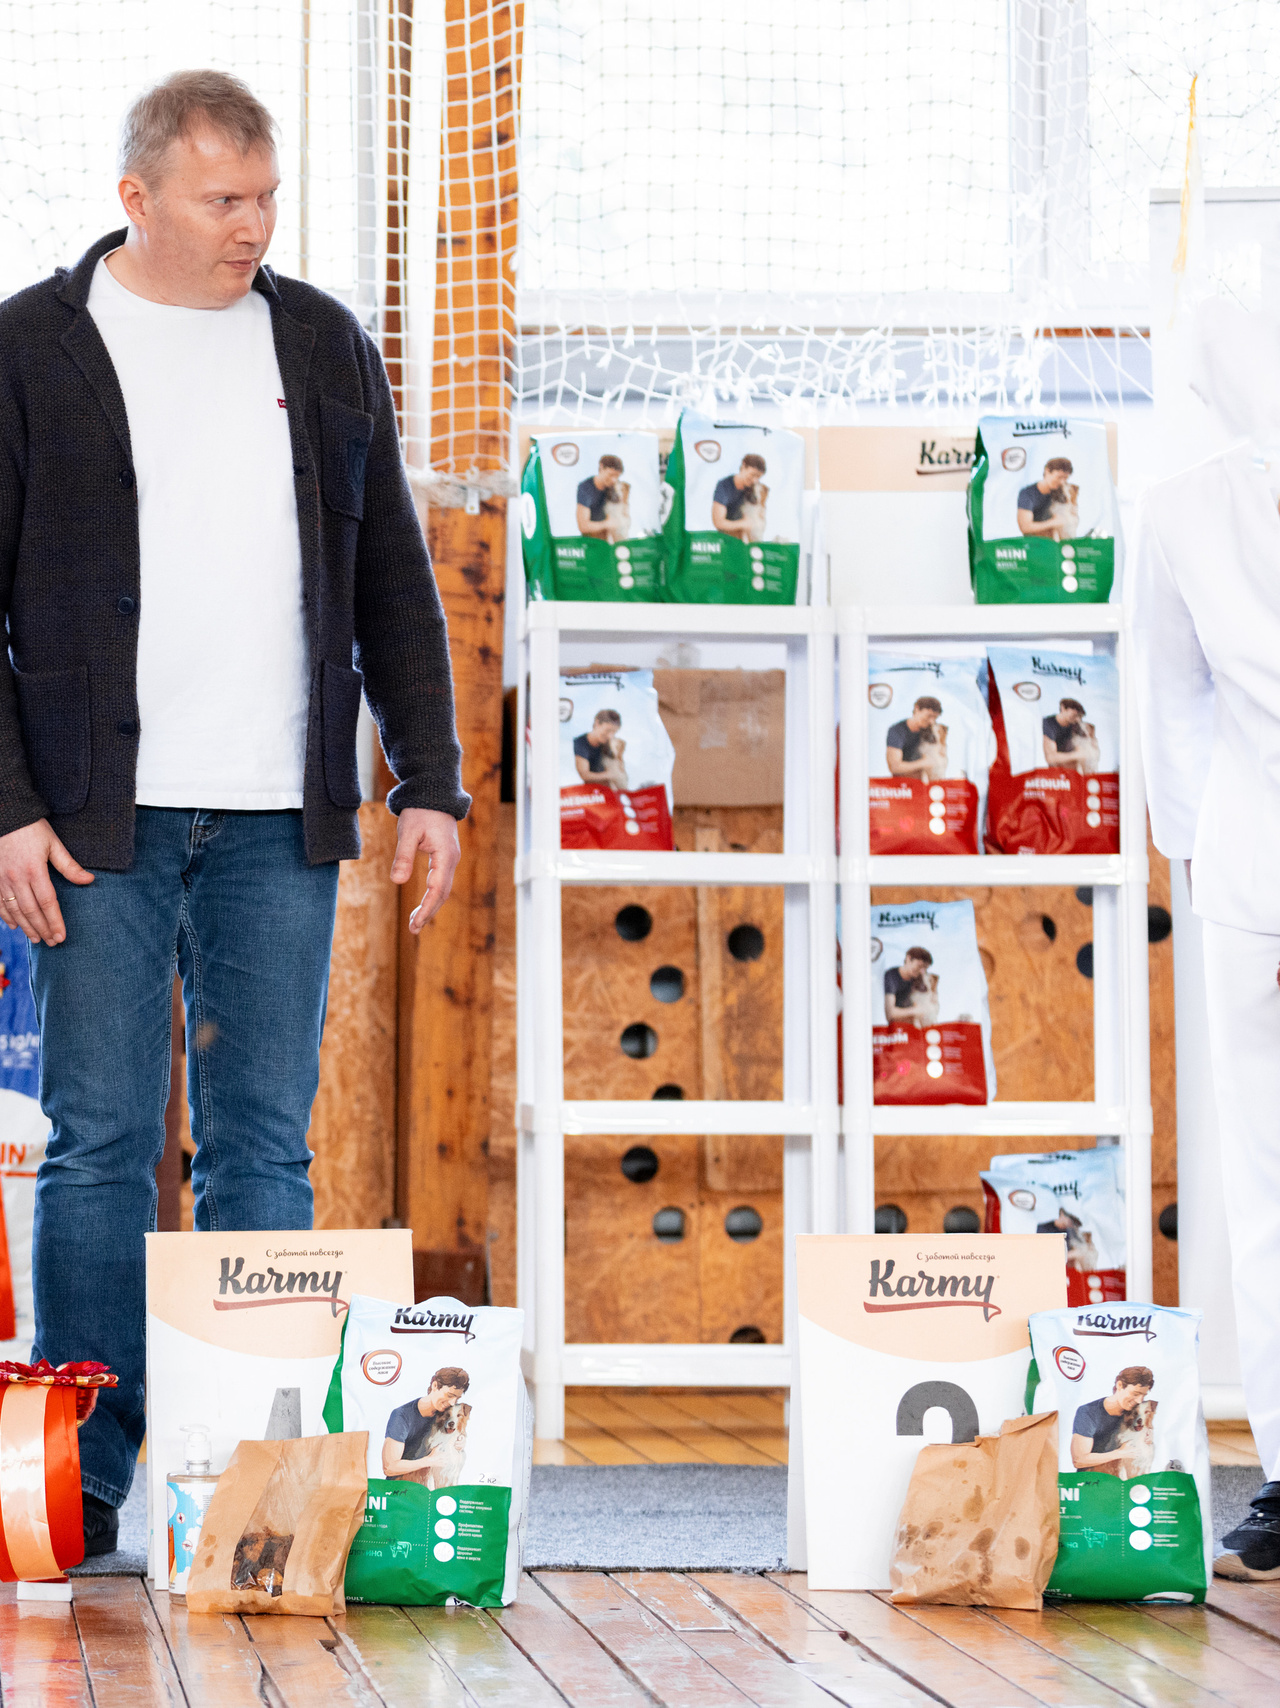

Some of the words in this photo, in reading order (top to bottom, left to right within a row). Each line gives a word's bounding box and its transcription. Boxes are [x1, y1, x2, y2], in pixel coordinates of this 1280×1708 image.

[920, 440, 973, 465] Kar
[557, 547, 585, 558] MINI
[691, 541, 721, 554] MINI
[996, 548, 1027, 560] MINI
[274, 1249, 308, 1259] заботой
[309, 1249, 344, 1258] навсегда
[925, 1252, 959, 1262] заботой
[961, 1253, 996, 1262] навсегда
[218, 1257, 343, 1318] Karmy
[869, 1259, 995, 1323] Karmy
[394, 1307, 474, 1344] Karmy
[1077, 1314, 1152, 1343] Karmy
[479, 1473, 485, 1483] 2
[1058, 1487, 1080, 1501] NI
[365, 1496, 387, 1510] NI
